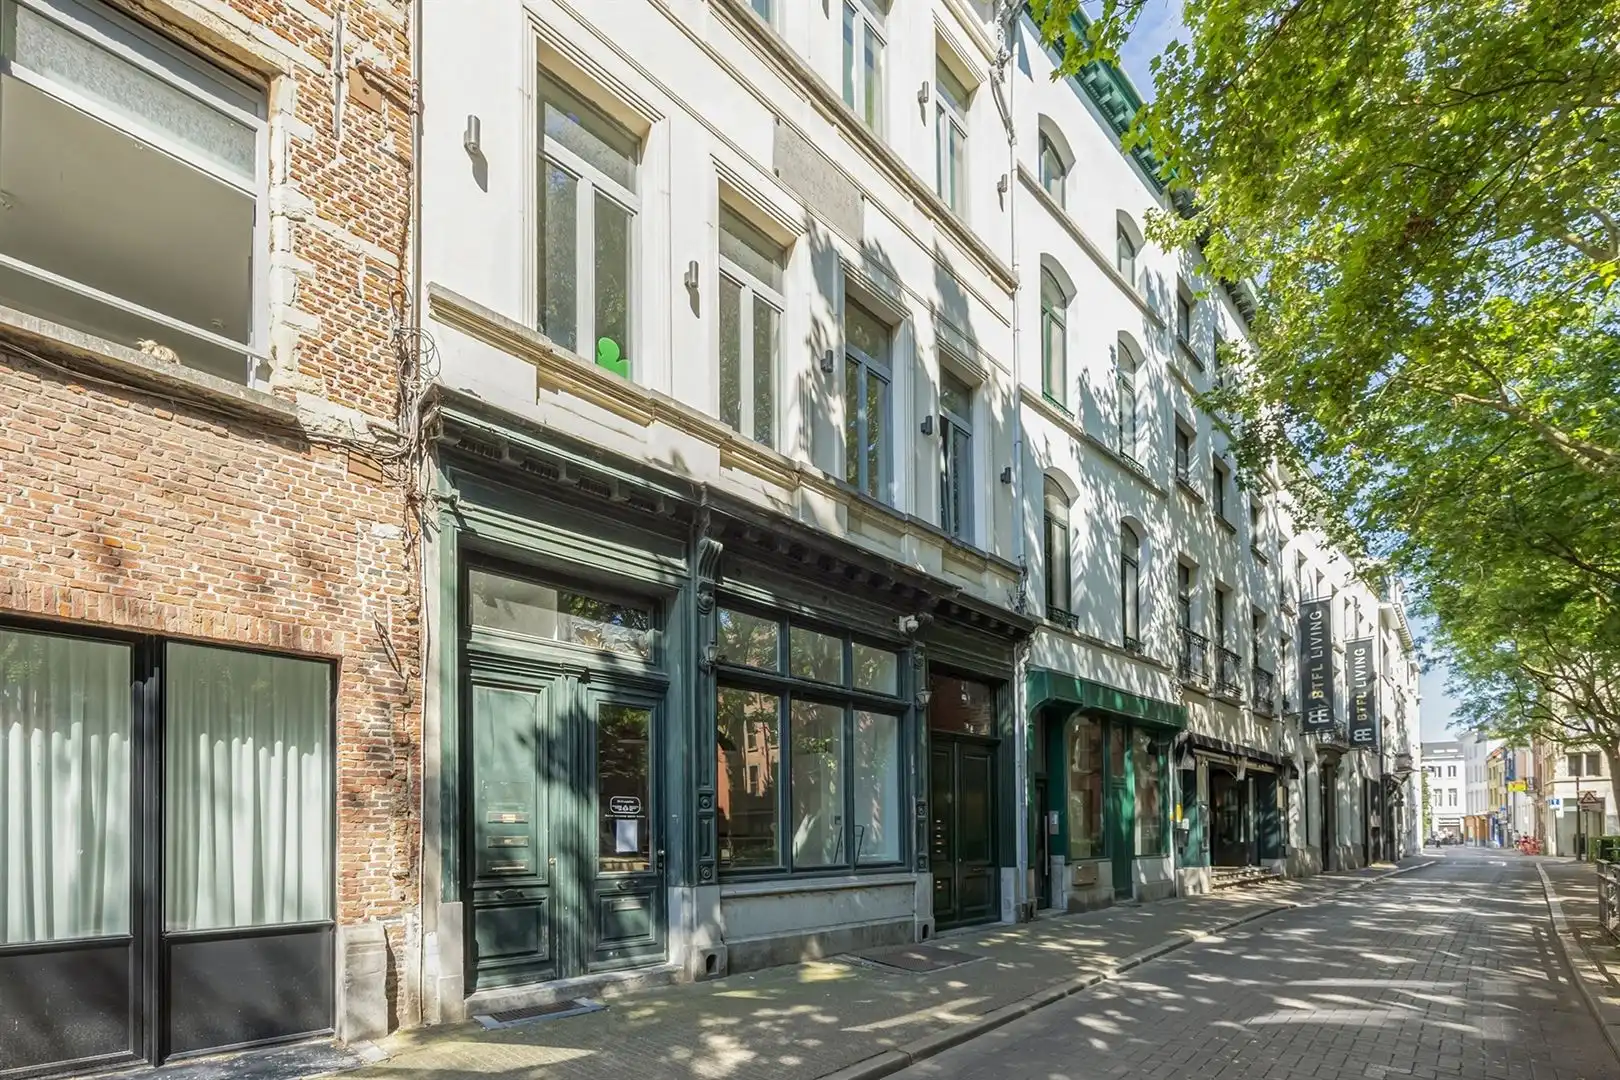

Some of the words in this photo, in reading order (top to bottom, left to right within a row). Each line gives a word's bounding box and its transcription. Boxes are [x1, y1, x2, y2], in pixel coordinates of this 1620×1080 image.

[1309, 610, 1323, 659] LIVING
[1310, 664, 1324, 699] BTFL
[1354, 647, 1367, 688] LIVING
[1356, 691, 1368, 721] BTFL
